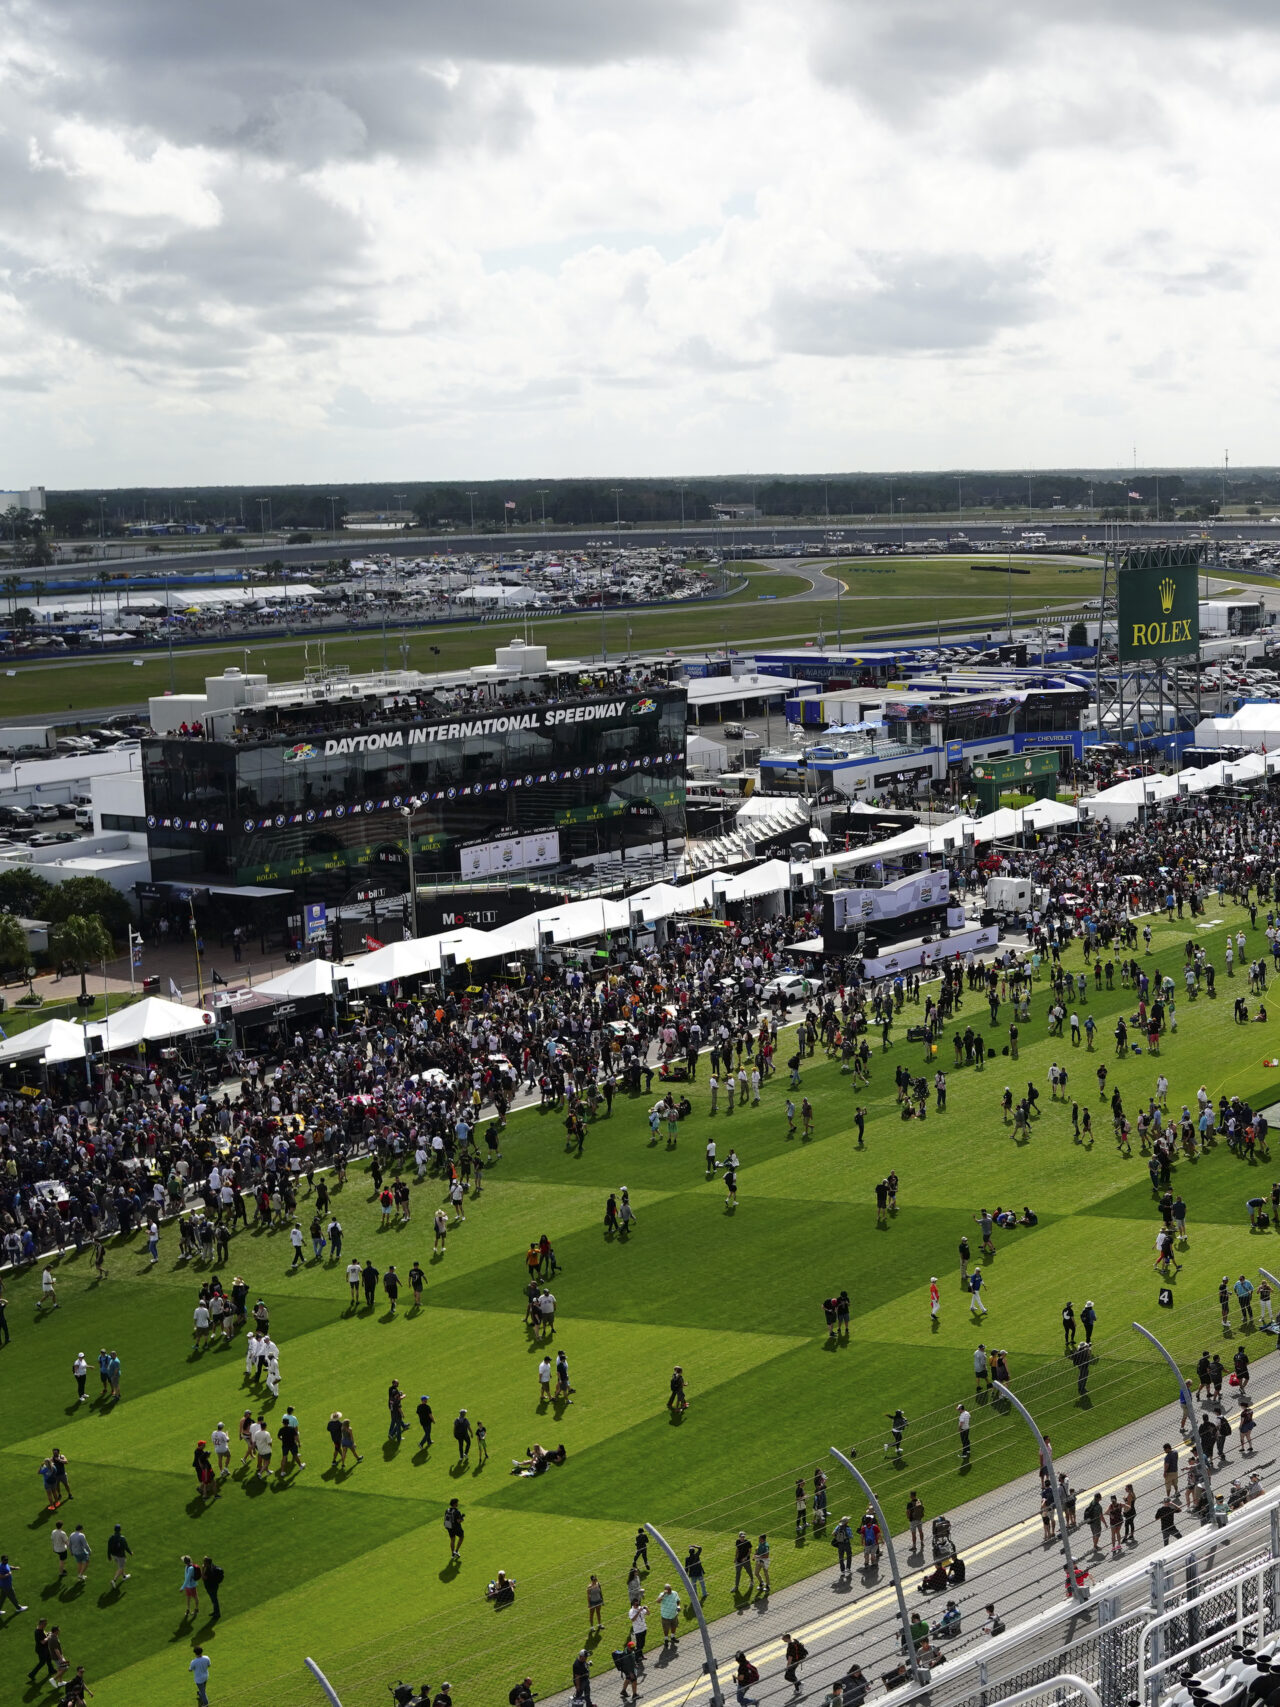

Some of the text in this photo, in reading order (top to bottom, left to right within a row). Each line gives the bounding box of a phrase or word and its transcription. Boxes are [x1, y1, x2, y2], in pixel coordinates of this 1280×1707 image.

[1132, 619, 1192, 646] ROLEX
[324, 702, 626, 756] DAYTONA INTERNATIONAL SPEEDWAY
[325, 860, 346, 869] ROLEX
[291, 866, 312, 875] ROLEX
[256, 872, 278, 882] ROLEX
[357, 889, 377, 900] Mobil
[272, 1003, 296, 1016] JDC
